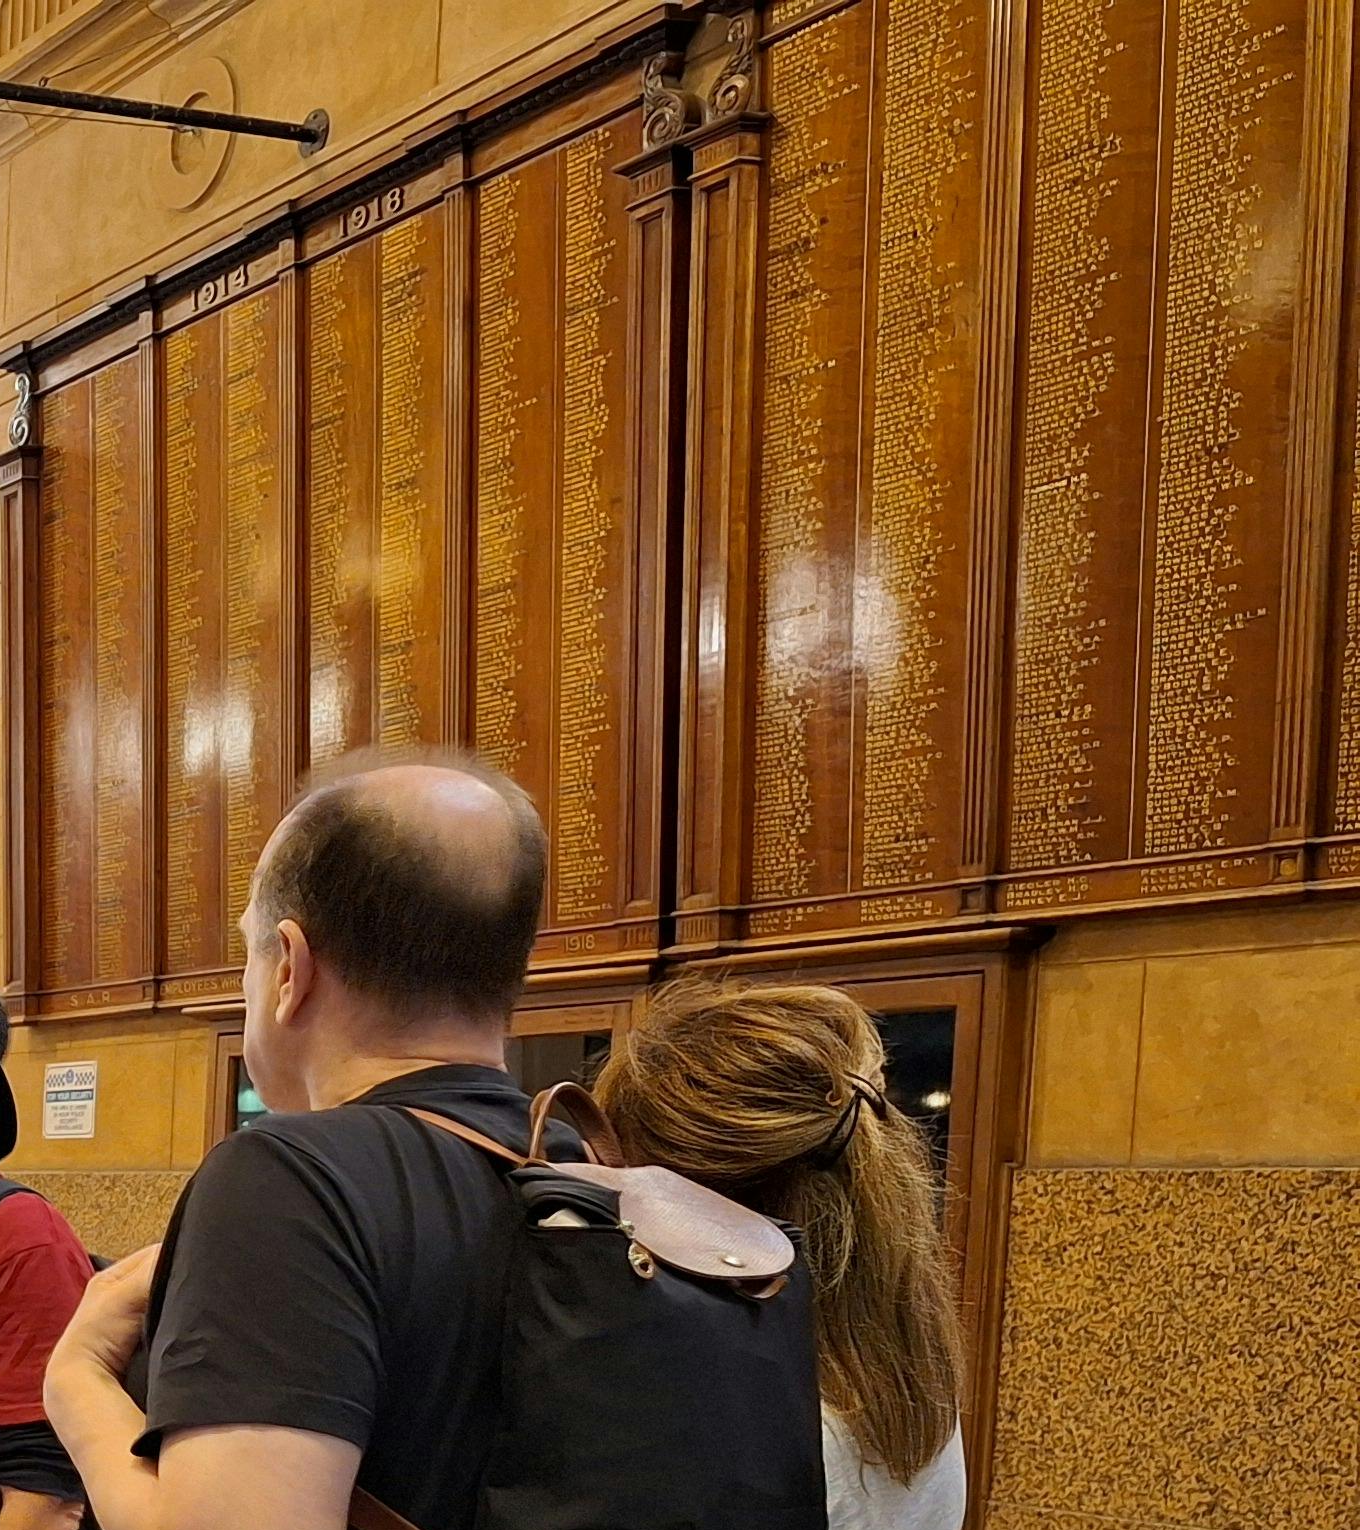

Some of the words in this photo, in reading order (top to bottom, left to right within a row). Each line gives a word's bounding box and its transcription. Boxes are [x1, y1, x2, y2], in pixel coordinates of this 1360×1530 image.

[339, 187, 404, 238] 1918
[190, 263, 249, 312] 1914
[564, 933, 597, 953] 1918
